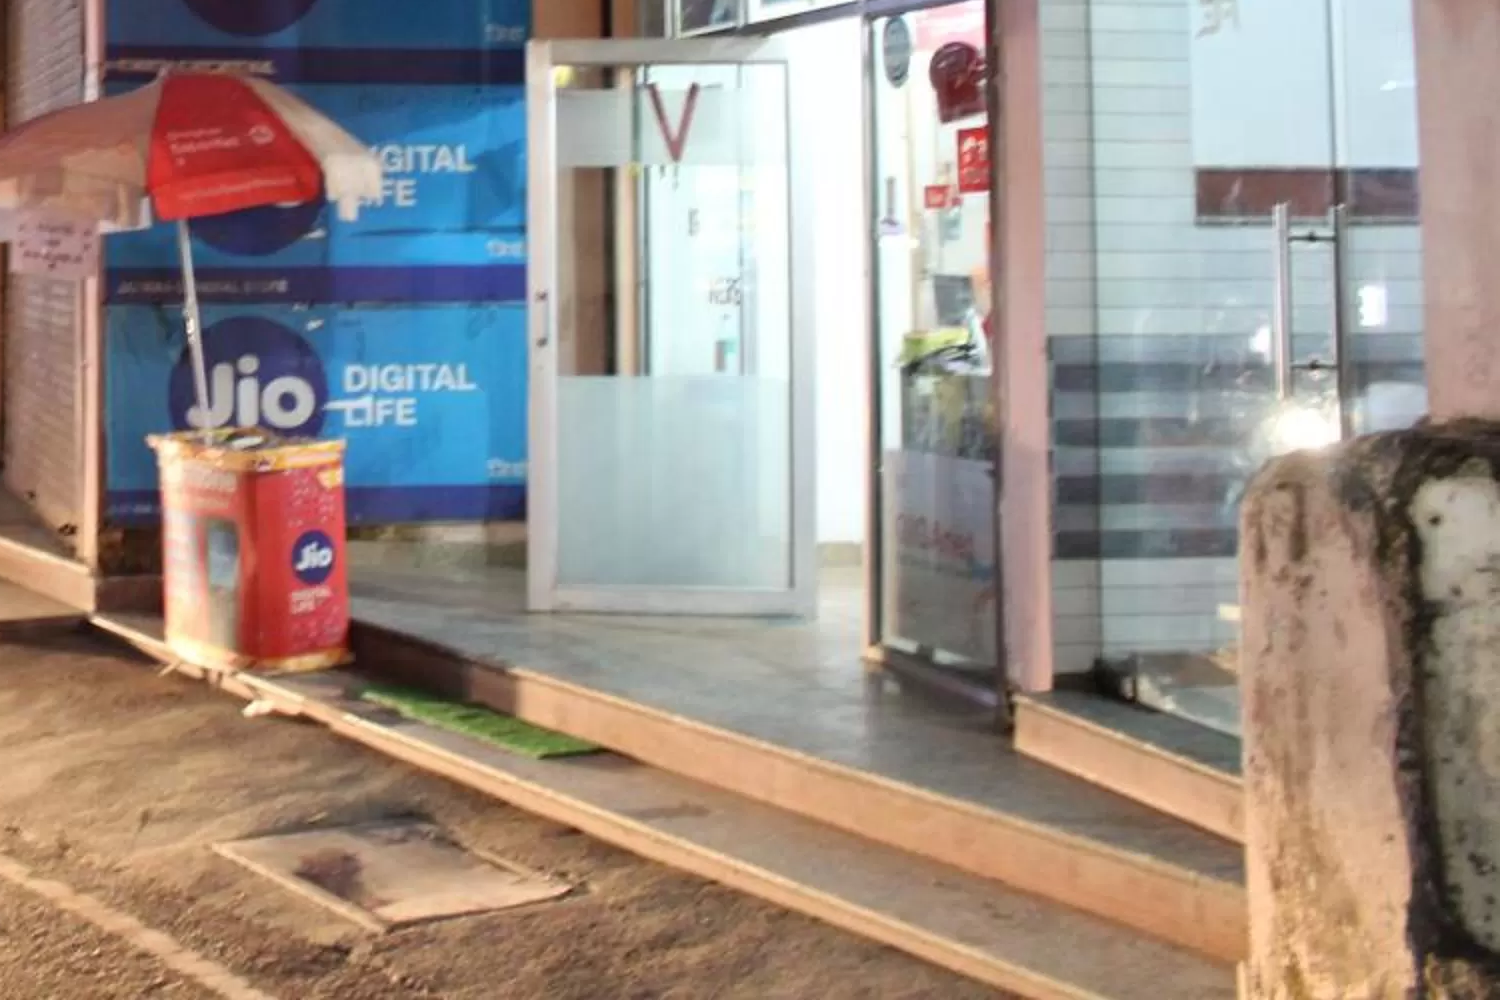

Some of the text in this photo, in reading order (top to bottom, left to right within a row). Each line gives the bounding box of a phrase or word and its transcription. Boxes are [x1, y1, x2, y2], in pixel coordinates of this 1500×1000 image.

[368, 143, 478, 173] GITAL
[185, 354, 316, 430] Jio
[343, 363, 477, 392] DIGITAL
[295, 540, 334, 571] Jio
